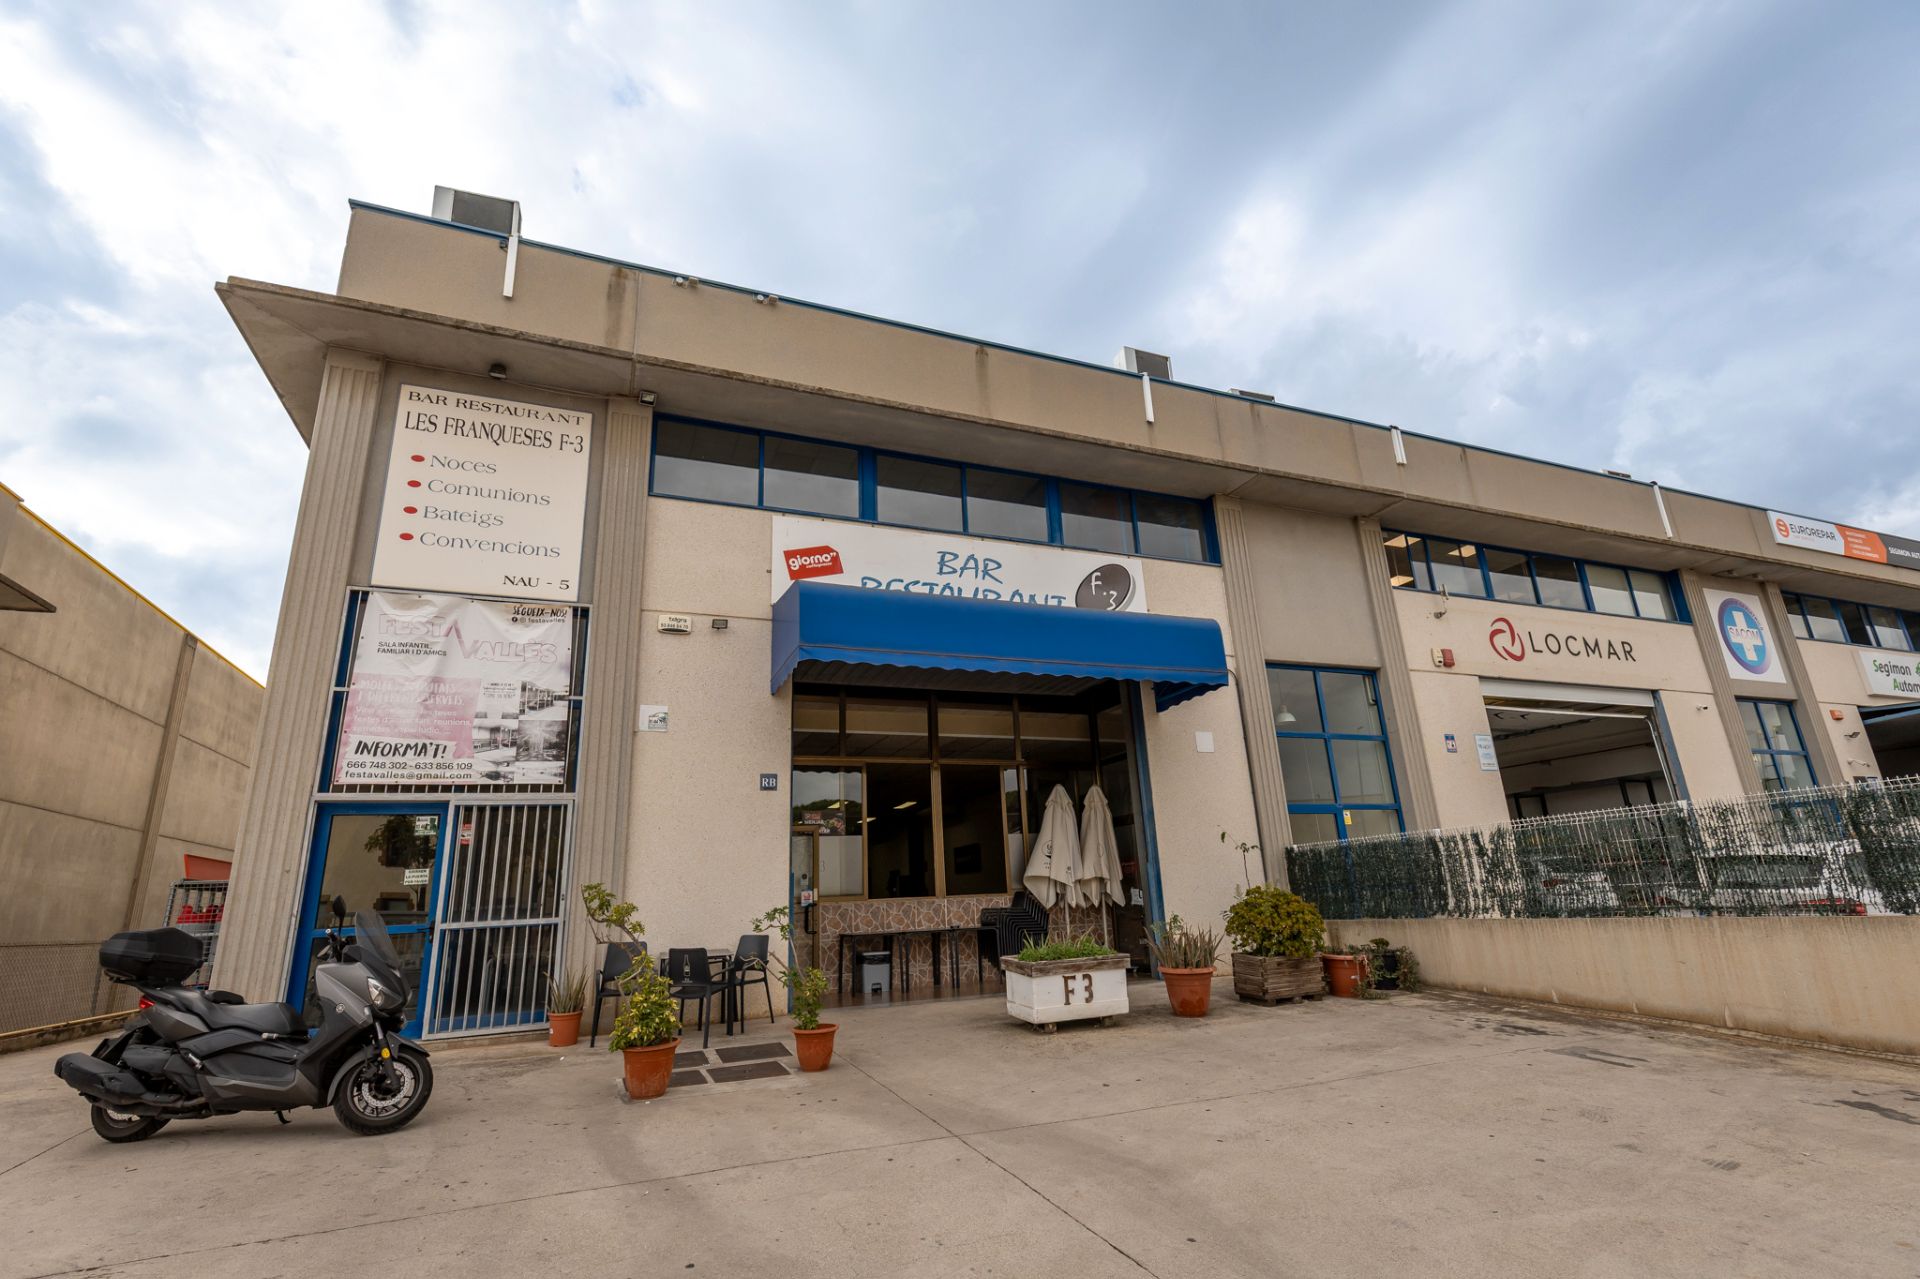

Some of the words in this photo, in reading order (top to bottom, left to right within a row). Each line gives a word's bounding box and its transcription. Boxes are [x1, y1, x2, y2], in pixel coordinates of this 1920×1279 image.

[408, 391, 448, 406] BAR
[455, 397, 584, 426] RESTAURANT
[404, 411, 438, 433] LES
[443, 416, 553, 449] FRANQUESES
[559, 433, 584, 454] F-3
[429, 454, 497, 474] Noces
[427, 479, 551, 506] Comunions
[423, 505, 504, 528] Bateigs
[1788, 523, 1837, 541] EUROREPAR
[419, 532, 561, 558] Convencions
[936, 550, 1004, 585] BAR
[503, 575, 540, 588] NAU
[559, 579, 570, 590] 5
[377, 647, 410, 655] FAMILIAR
[1527, 630, 1637, 662] LOCMAR
[1872, 659, 1912, 677] Segimon
[354, 740, 448, 759] INFORMA'T!
[346, 760, 367, 769] 666
[369, 761, 386, 769] 748
[388, 761, 407, 770] 302
[415, 762, 433, 770] 633
[436, 762, 454, 770] 856
[456, 762, 473, 770] 109
[345, 770, 472, 780] festavalles@gmail.com
[761, 777, 777, 788] RB
